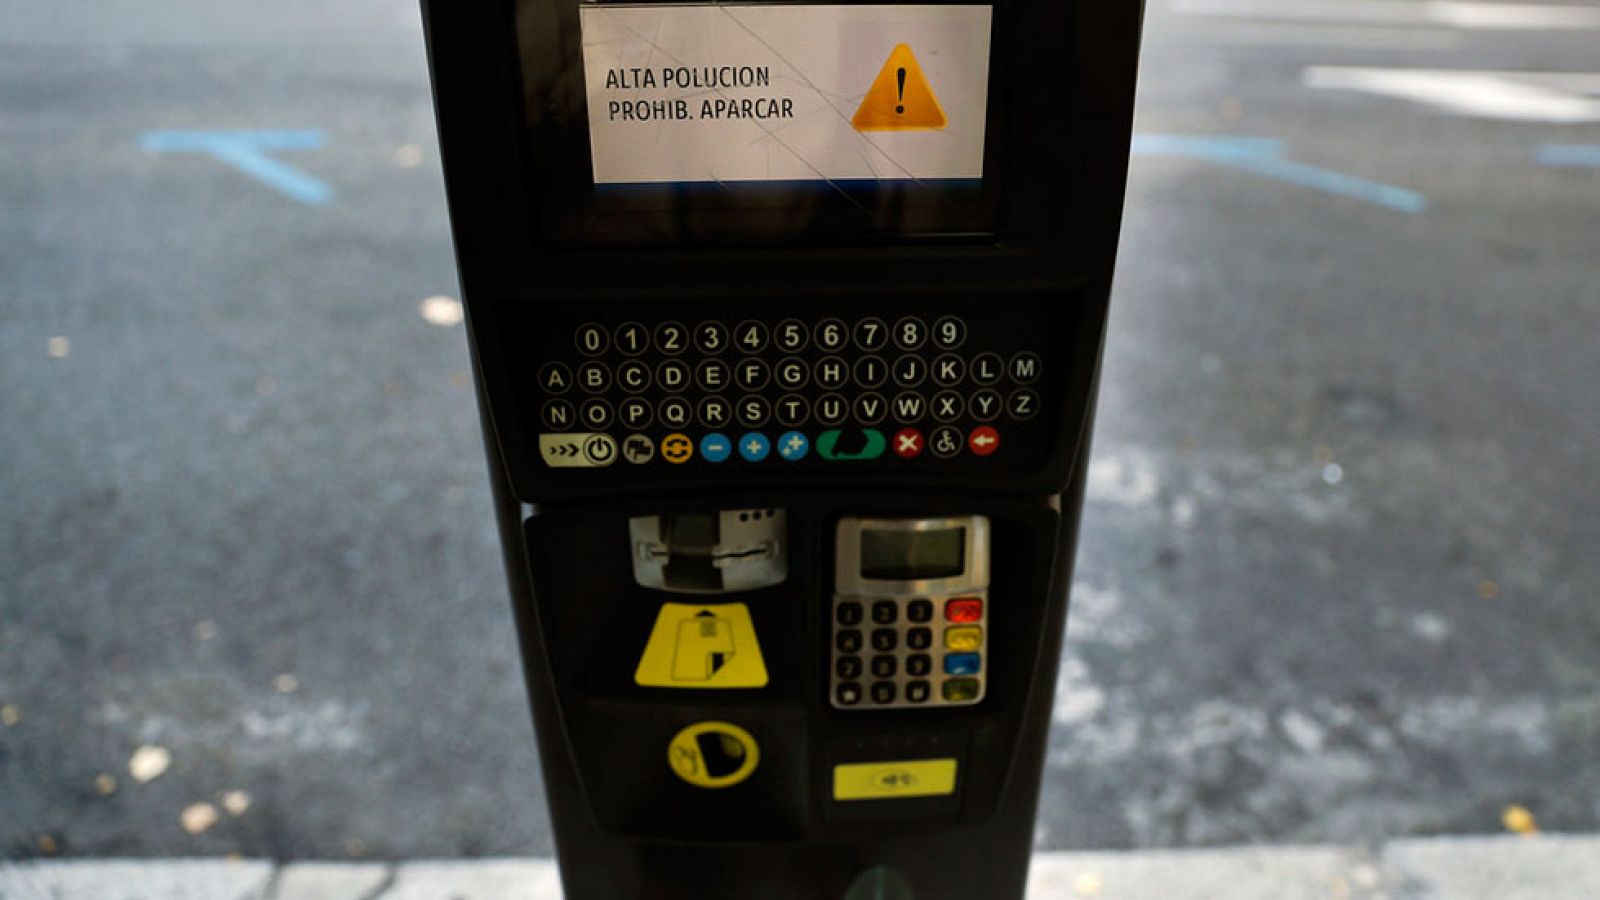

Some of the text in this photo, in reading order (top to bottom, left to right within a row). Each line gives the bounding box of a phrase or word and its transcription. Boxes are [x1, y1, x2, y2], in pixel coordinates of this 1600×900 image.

[605, 66, 770, 89] ALTA POLUCION
[608, 97, 794, 121] PROHIB. APARCAR
[664, 327, 680, 349] 2
[704, 326, 719, 349] 3
[743, 326, 760, 347] 4
[784, 325, 800, 347] 5
[823, 324, 839, 346] 6
[863, 324, 878, 345] 7
[902, 322, 917, 344] 8
[941, 322, 957, 344] 9
[547, 369, 565, 387] A
[587, 368, 603, 386] B
[626, 367, 642, 386] C
[665, 367, 682, 385] D
[706, 366, 721, 385] E
[746, 365, 760, 383] F
[783, 365, 801, 383] G
[824, 363, 840, 382] H
[903, 362, 916, 380] J
[941, 361, 956, 379] K
[980, 360, 994, 378] L
[1016, 359, 1034, 377] M
[551, 395, 1031, 424] N O P Q R S T U V W X Y Z
